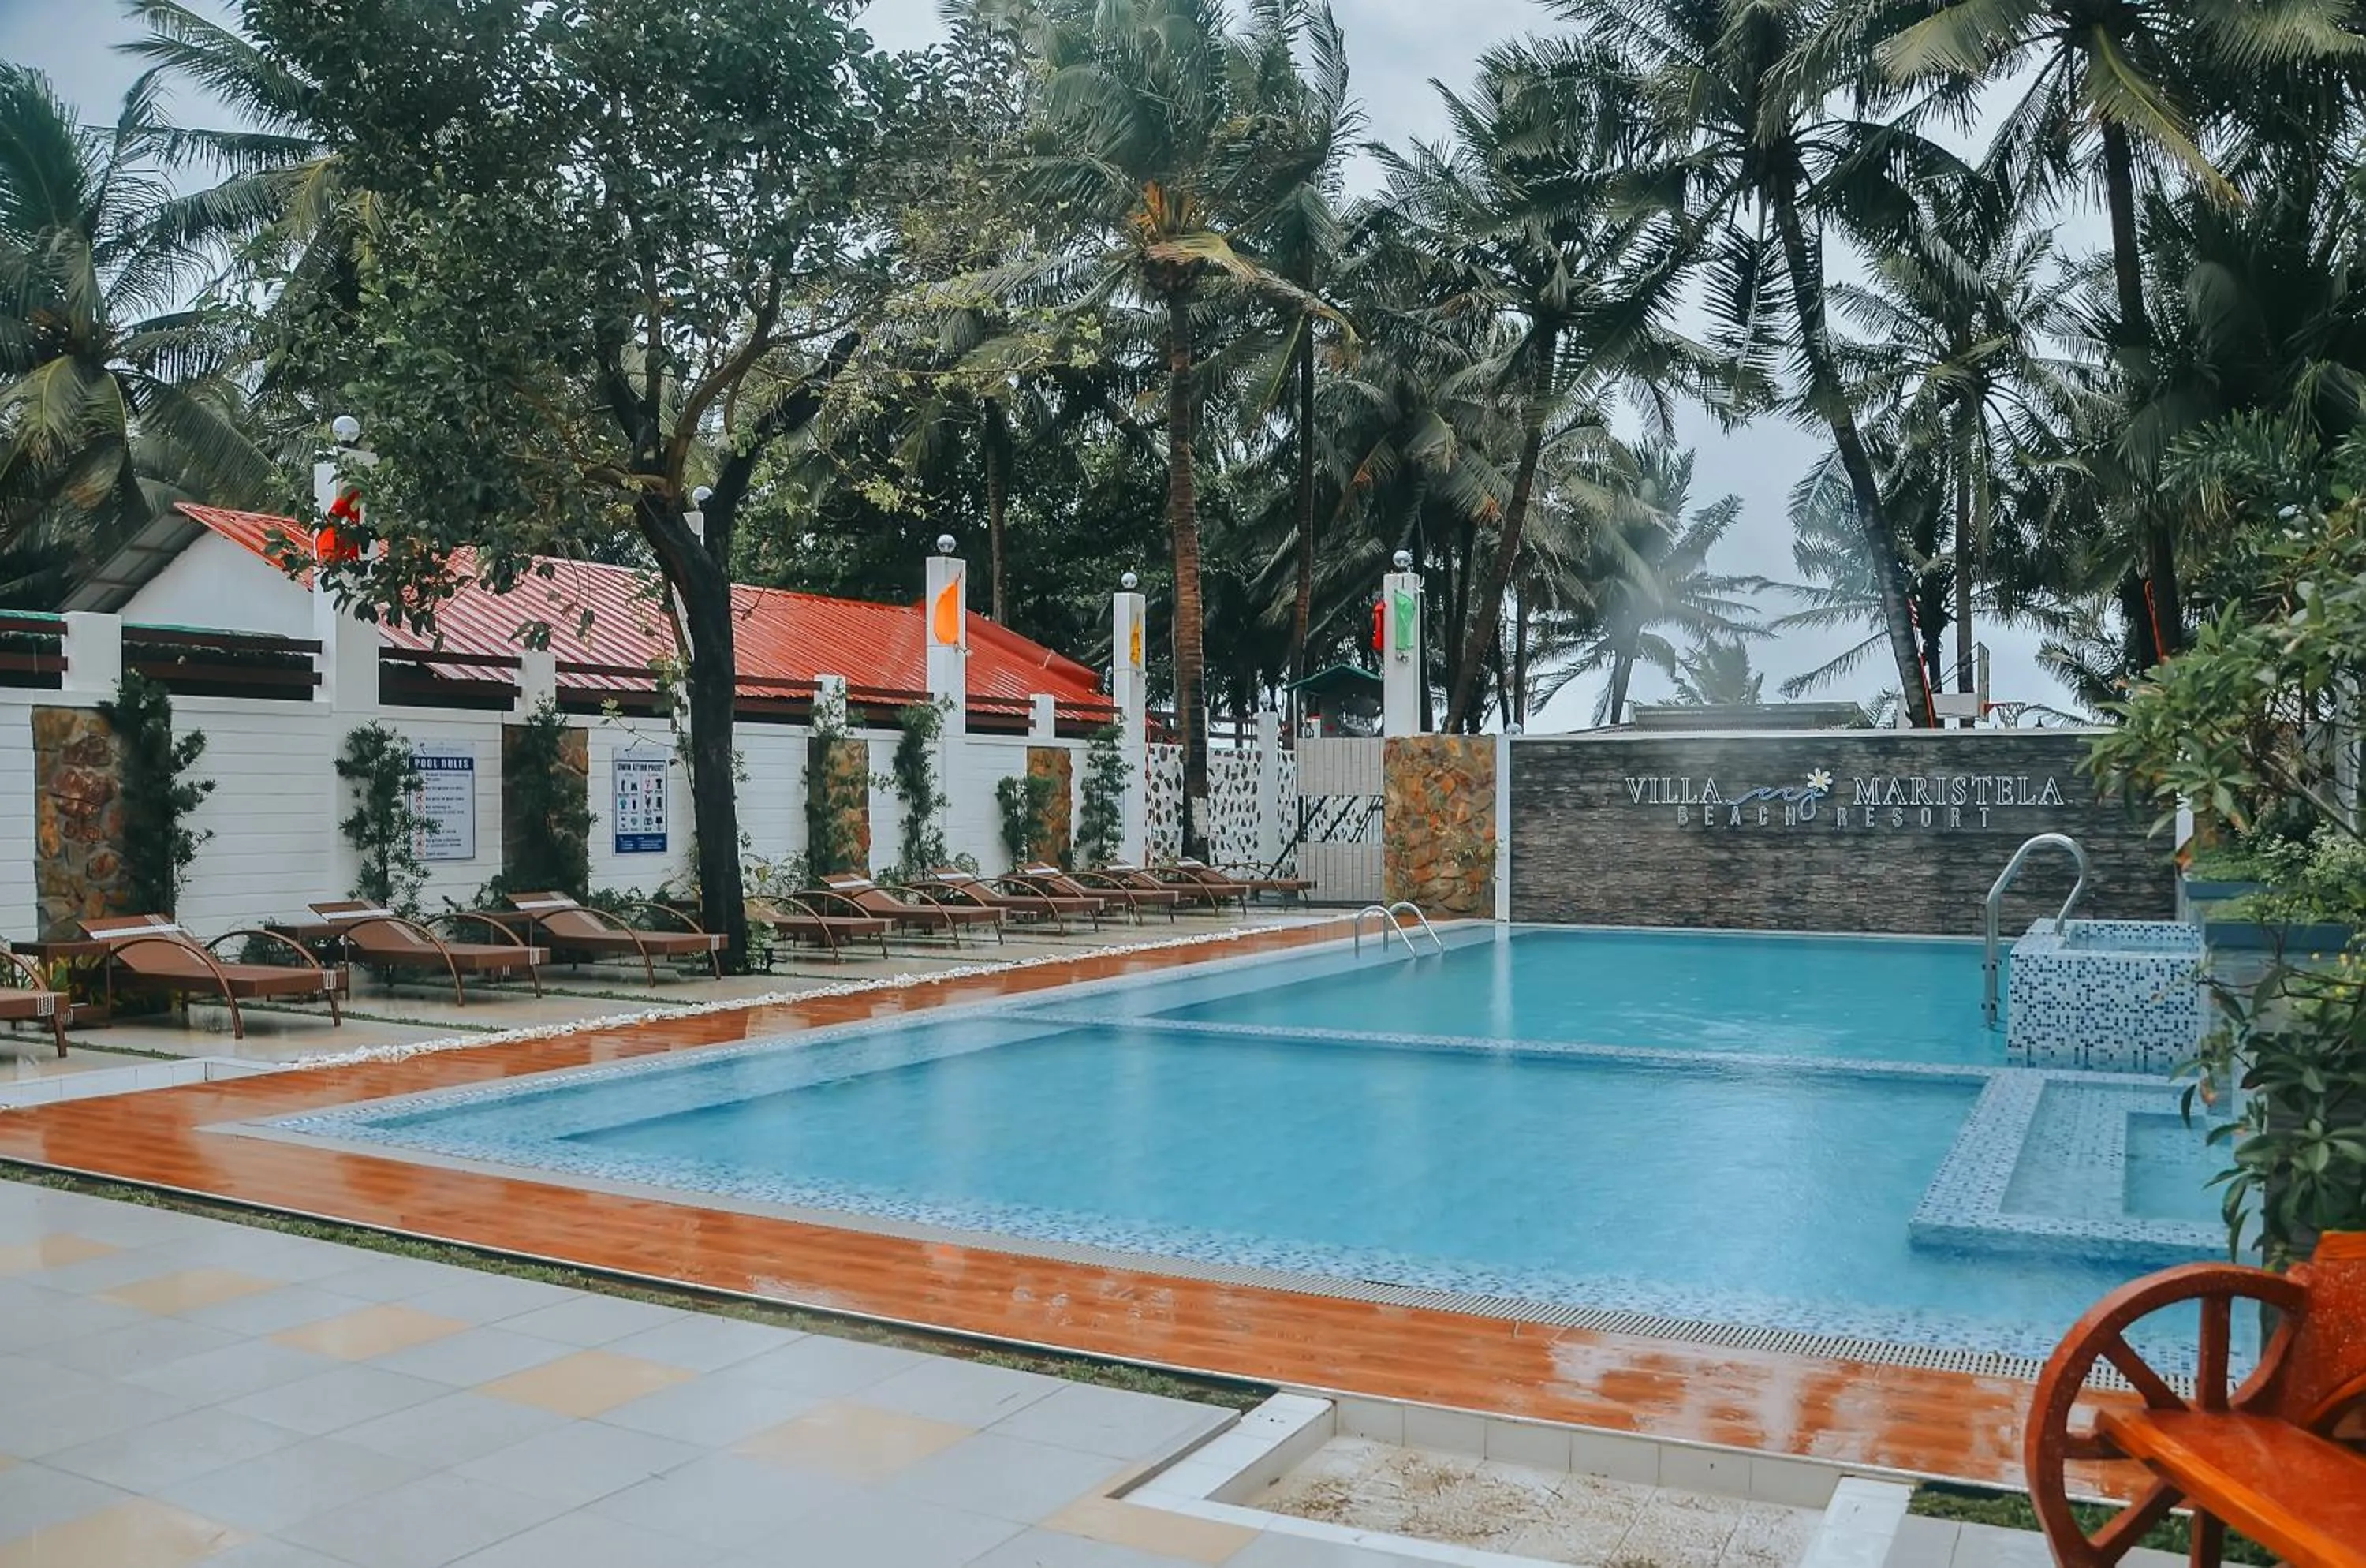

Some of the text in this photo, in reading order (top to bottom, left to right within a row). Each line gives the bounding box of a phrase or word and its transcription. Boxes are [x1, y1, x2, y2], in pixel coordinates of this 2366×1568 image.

[414, 758, 468, 769] POOL RULES
[1625, 775, 2065, 805] VILLA MARISTELA
[1677, 805, 1990, 828] BEACH RESORT
